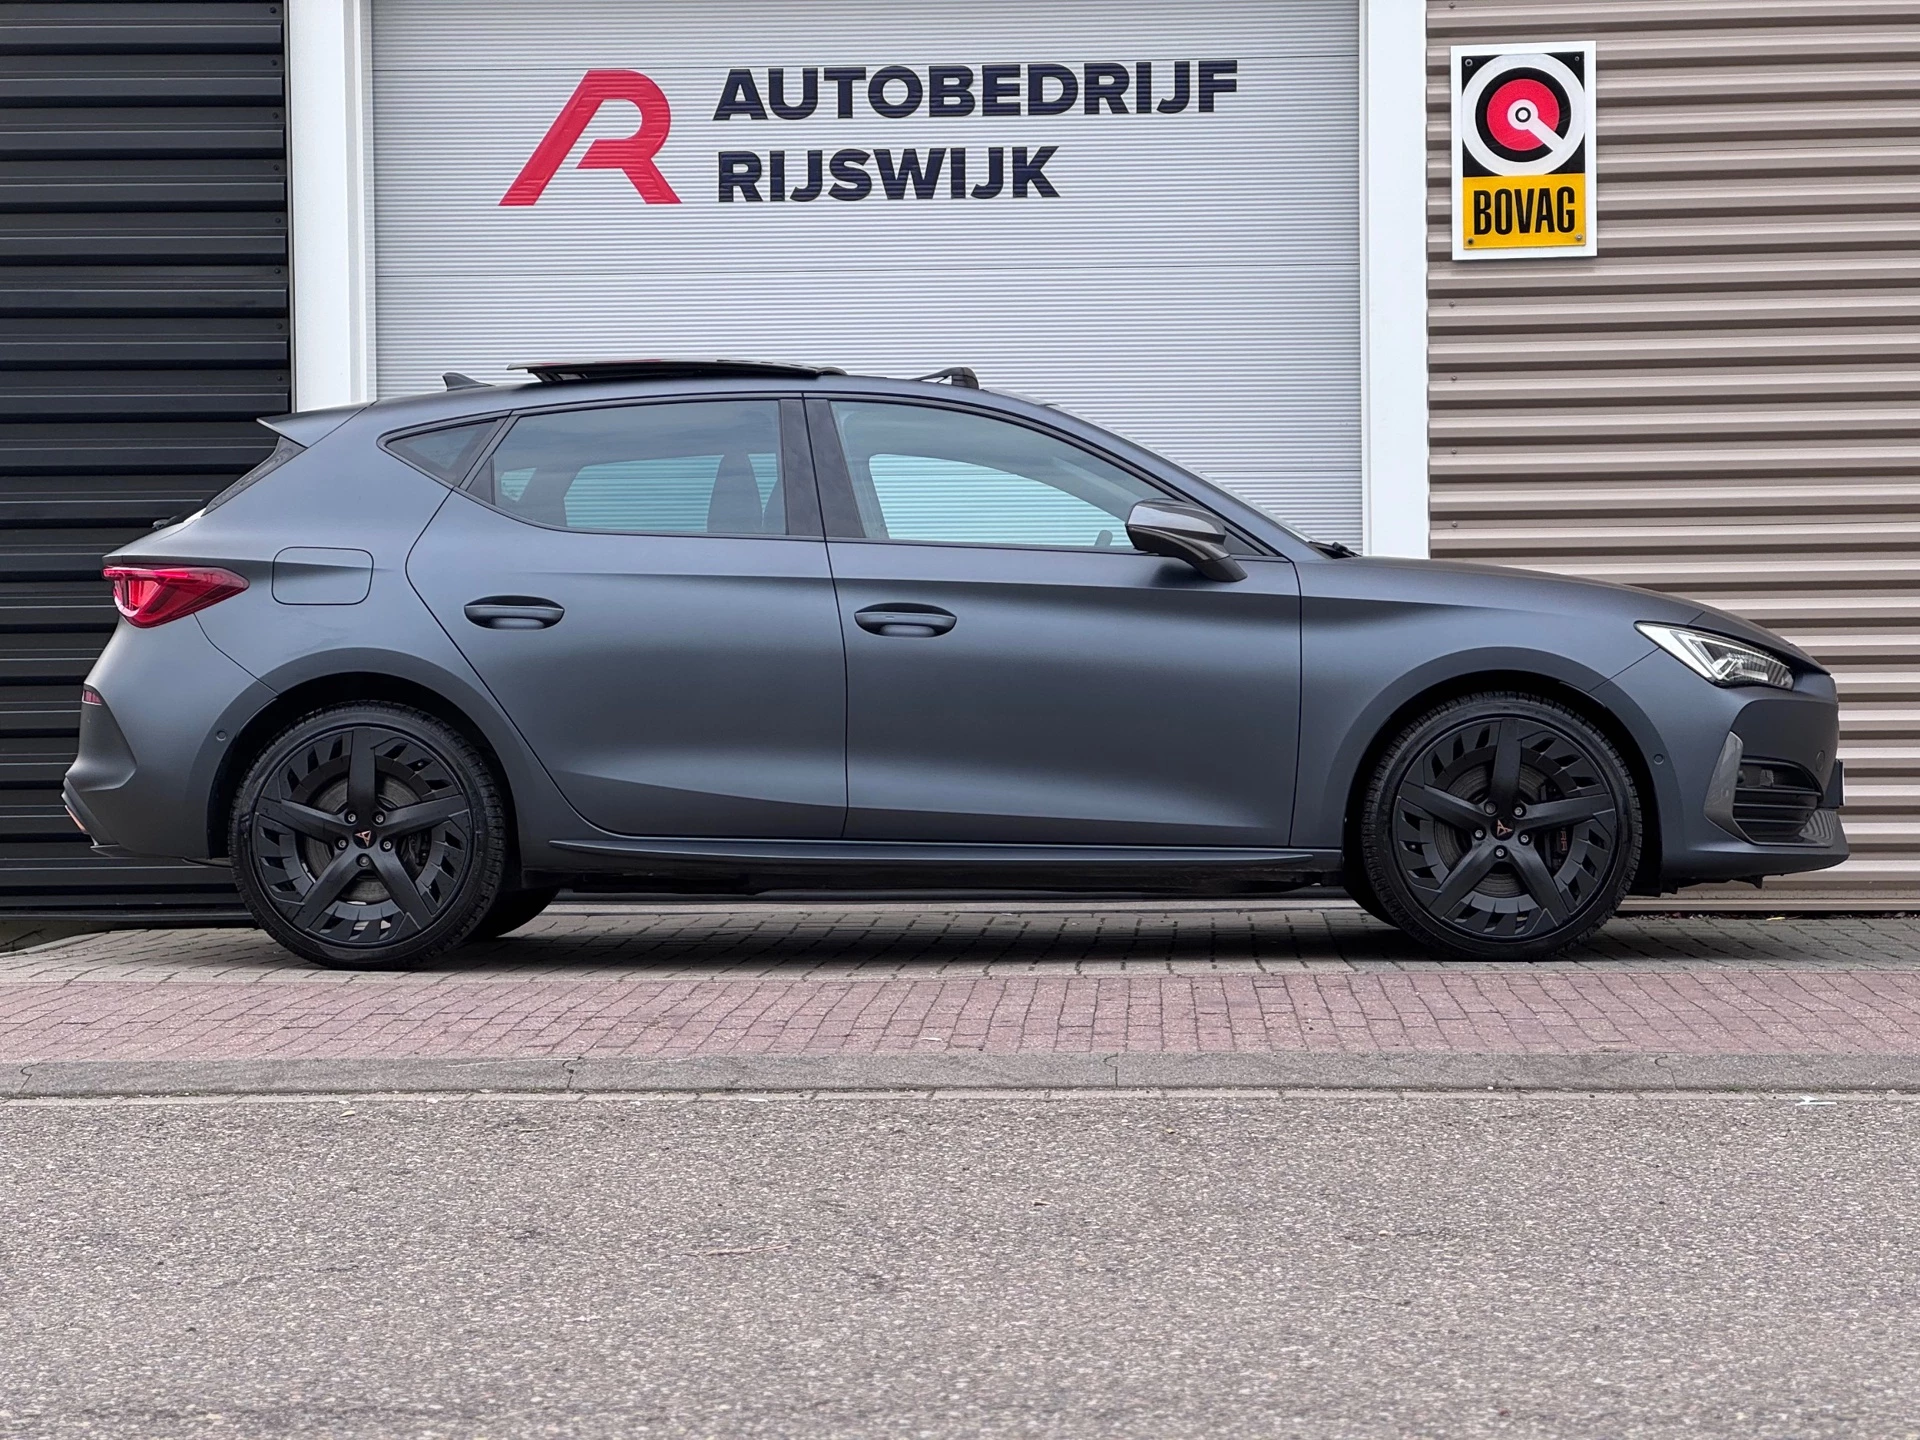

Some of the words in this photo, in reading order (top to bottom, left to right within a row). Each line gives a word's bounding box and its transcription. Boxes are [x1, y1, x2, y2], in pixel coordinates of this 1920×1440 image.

[713, 60, 1238, 121] AUTOBEDRIJF
[718, 145, 1060, 203] RIJSWIJK
[1473, 186, 1576, 236] BOVAG
